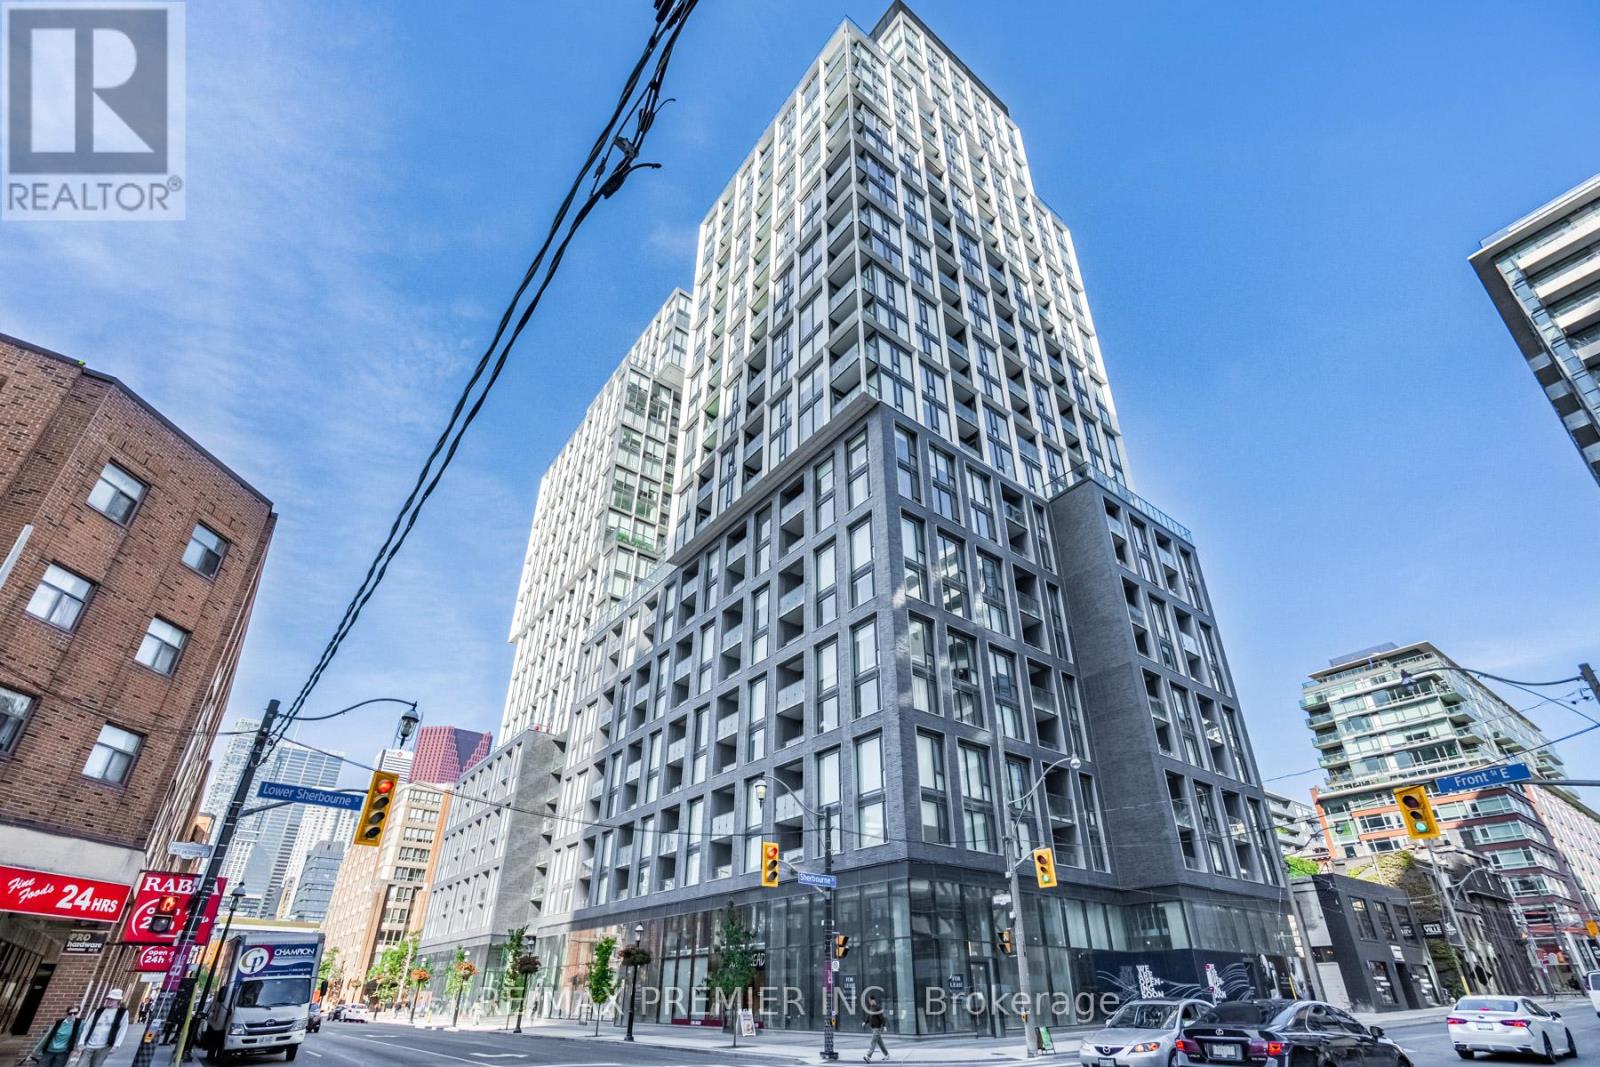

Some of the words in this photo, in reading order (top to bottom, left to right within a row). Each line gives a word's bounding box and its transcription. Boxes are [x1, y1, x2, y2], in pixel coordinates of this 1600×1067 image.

[1454, 772, 1489, 787] Front
[1500, 767, 1510, 779] E
[263, 783, 294, 797] Lower
[296, 788, 352, 806] Sherbourne
[8, 877, 35, 894] Fine
[800, 873, 831, 884] Sherbourne
[141, 876, 220, 896] RABA
[18, 883, 55, 904] Foods
[55, 884, 95, 911] 24
[90, 897, 118, 913] HRS
[69, 933, 91, 941] PRO
[274, 947, 315, 956] CHAMPION
[144, 955, 165, 963] 24h
[1136, 964, 1150, 972] WE
[1141, 990, 1165, 999] SOON
